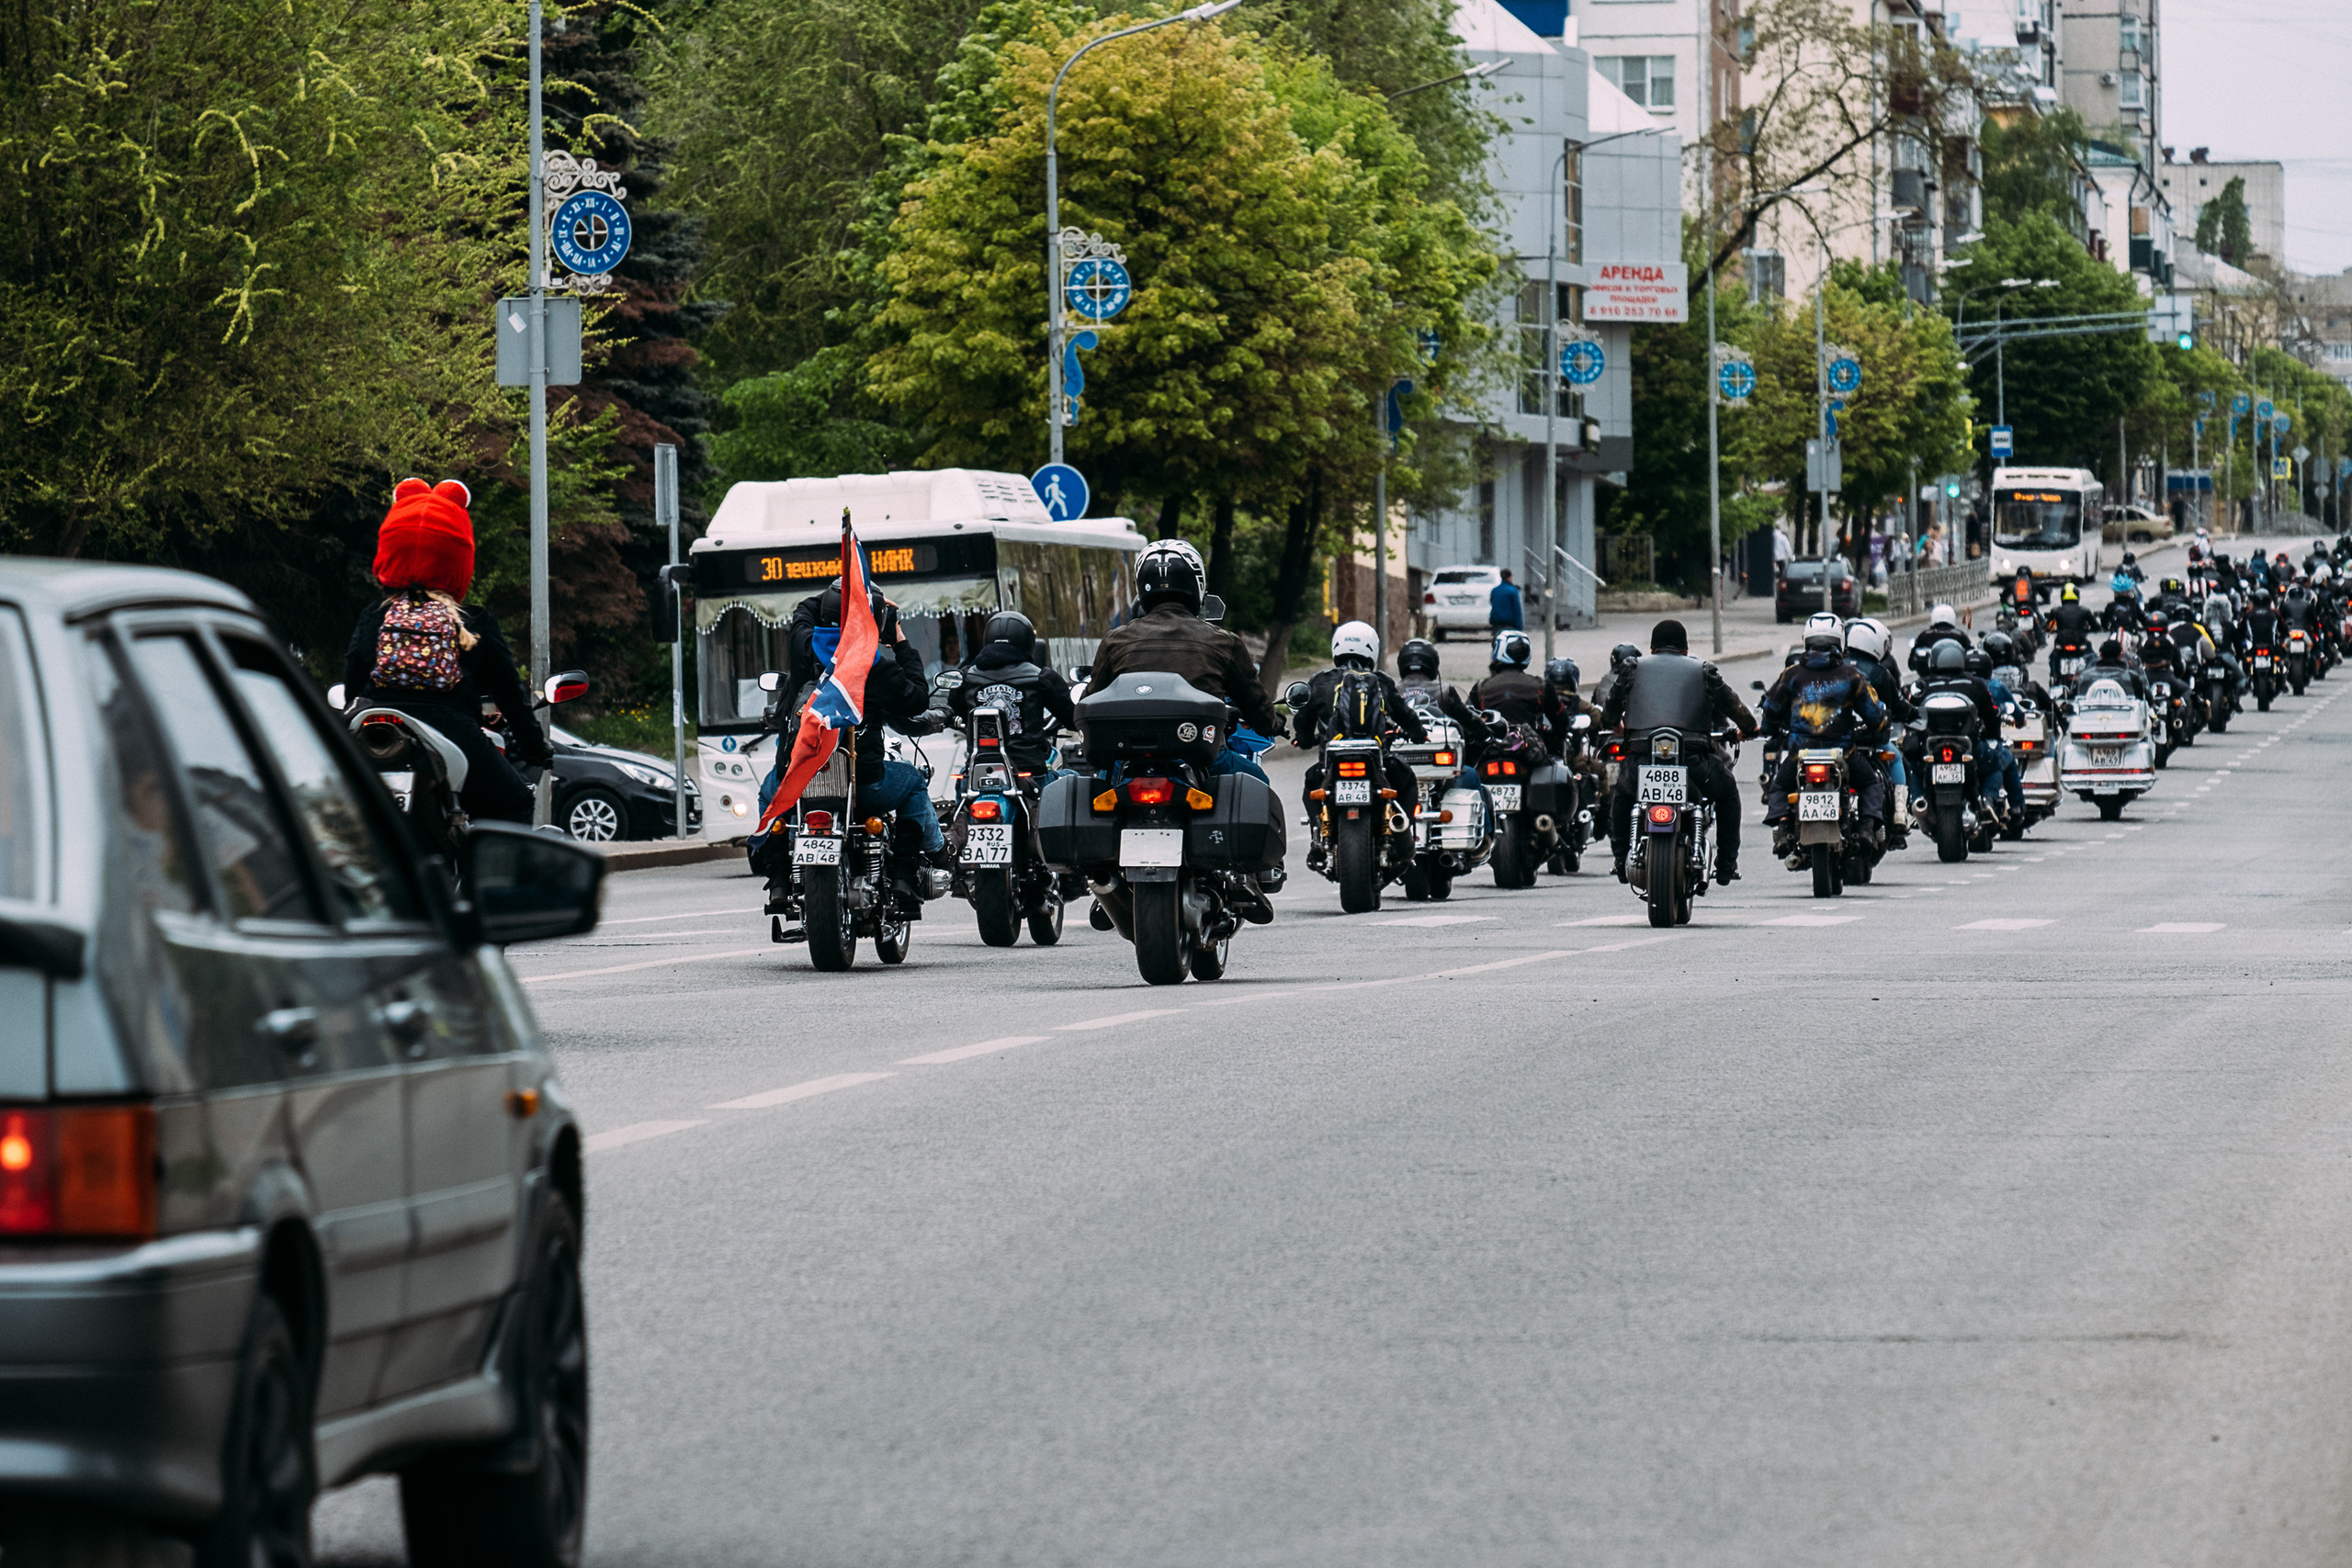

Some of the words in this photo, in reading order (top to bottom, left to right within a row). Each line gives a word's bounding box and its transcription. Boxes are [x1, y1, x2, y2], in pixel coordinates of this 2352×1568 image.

[1600, 265, 1664, 282] АРЕНДА
[761, 557, 783, 581] 30
[1645, 770, 1679, 783] 4888
[1341, 782, 1366, 790] 3374
[1490, 787, 1516, 795] 4873
[1667, 788, 1683, 801] 48
[1506, 800, 1518, 808] 77
[1805, 795, 1834, 805] 9812
[1823, 809, 1837, 818] 48
[967, 828, 1004, 841] 9332
[803, 840, 834, 850] 4842
[820, 853, 836, 863] 48
[989, 847, 1008, 861] 77
